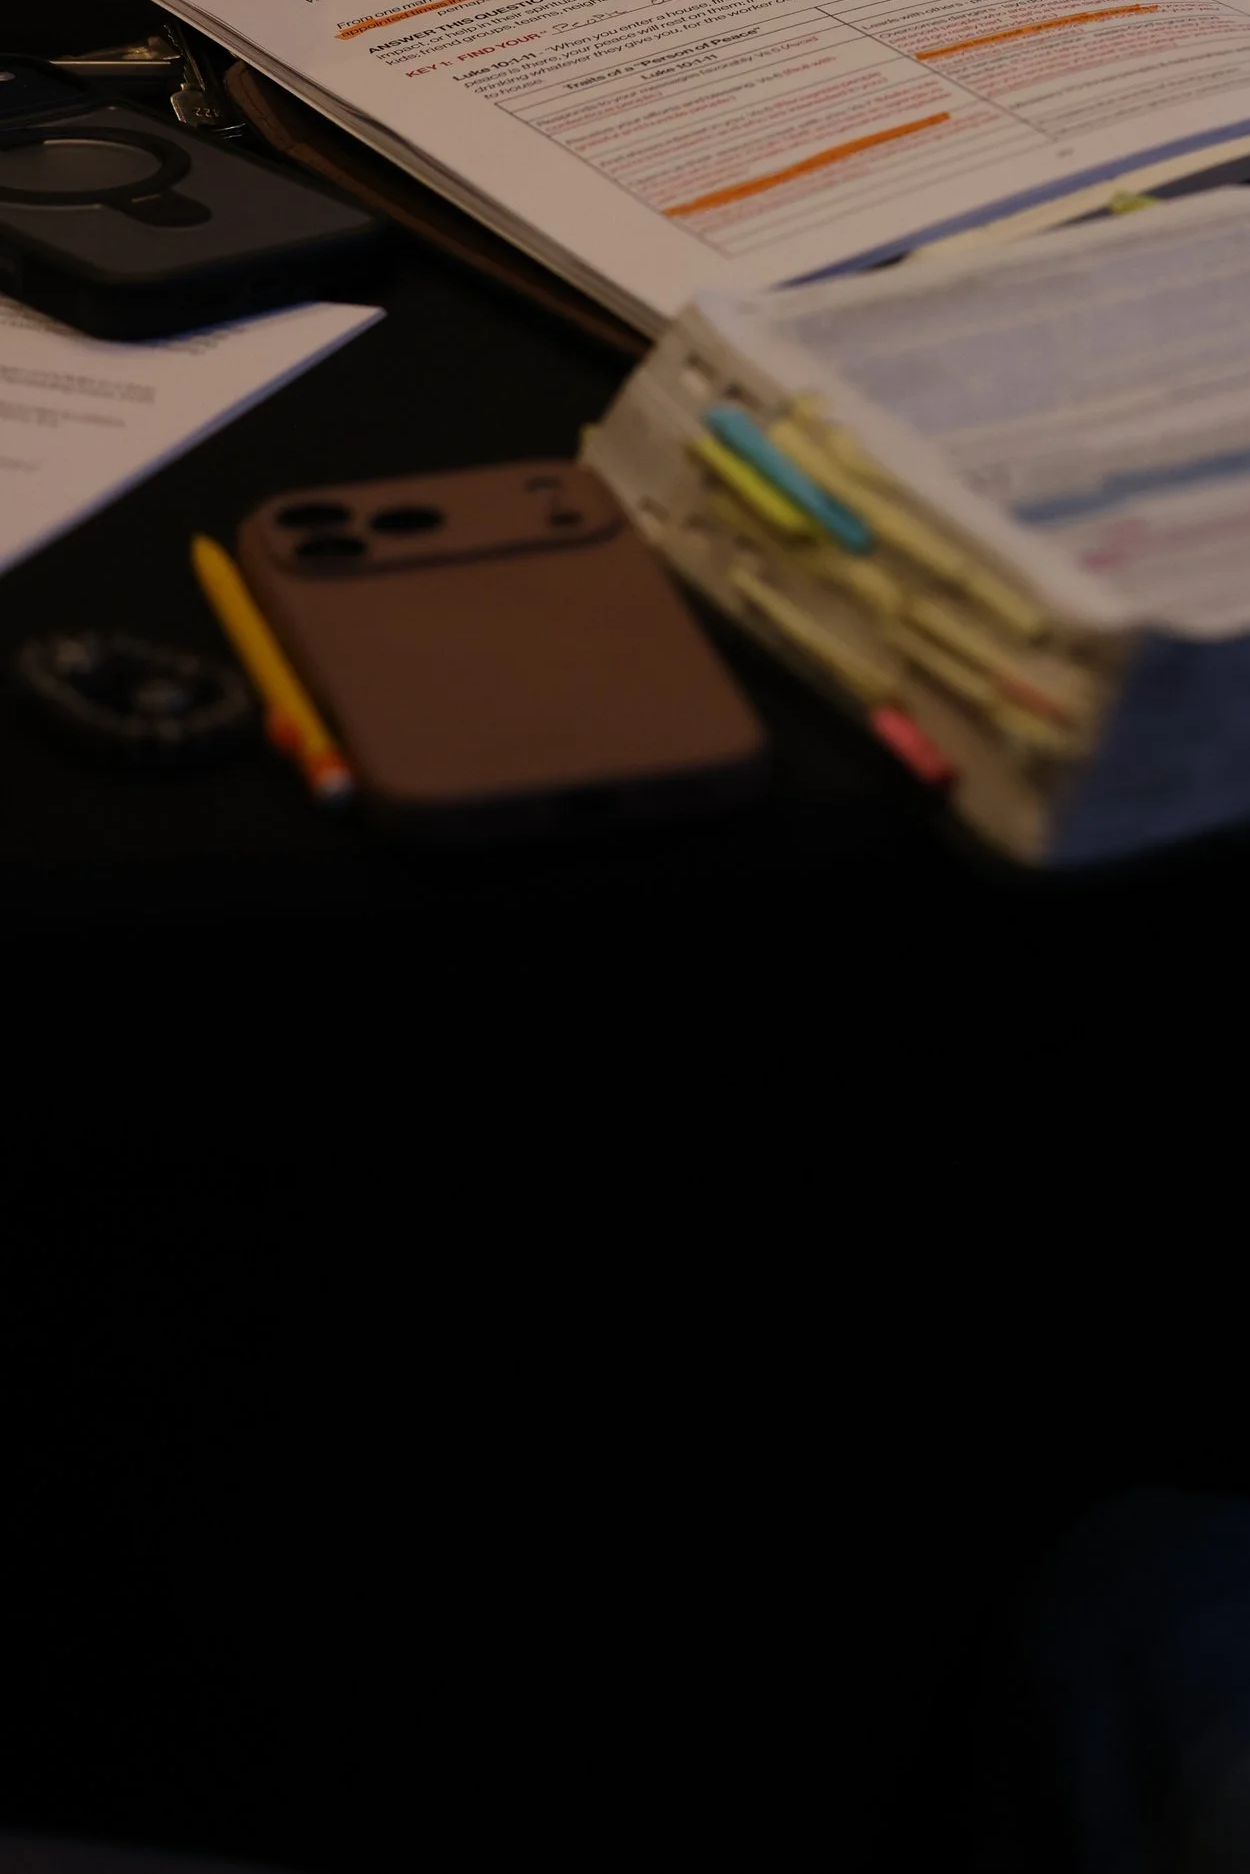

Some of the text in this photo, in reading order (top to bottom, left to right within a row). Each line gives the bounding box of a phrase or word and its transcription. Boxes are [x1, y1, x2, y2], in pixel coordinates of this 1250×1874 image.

[337, 16, 374, 29] From
[375, 7, 401, 18] one
[369, 29, 436, 54] ANSWER
[436, 18, 474, 31] THIS
[376, 42, 430, 60] impact,
[445, 27, 477, 38] help
[491, 13, 522, 24] their
[406, 64, 437, 78] KEY
[457, 47, 495, 61] FIND
[495, 34, 541, 48] YOUR
[452, 68, 491, 81] Luke
[491, 53, 537, 69] 10:1-11
[592, 29, 618, 40] you
[619, 18, 653, 31] enter
[665, 3, 712, 18] house,
